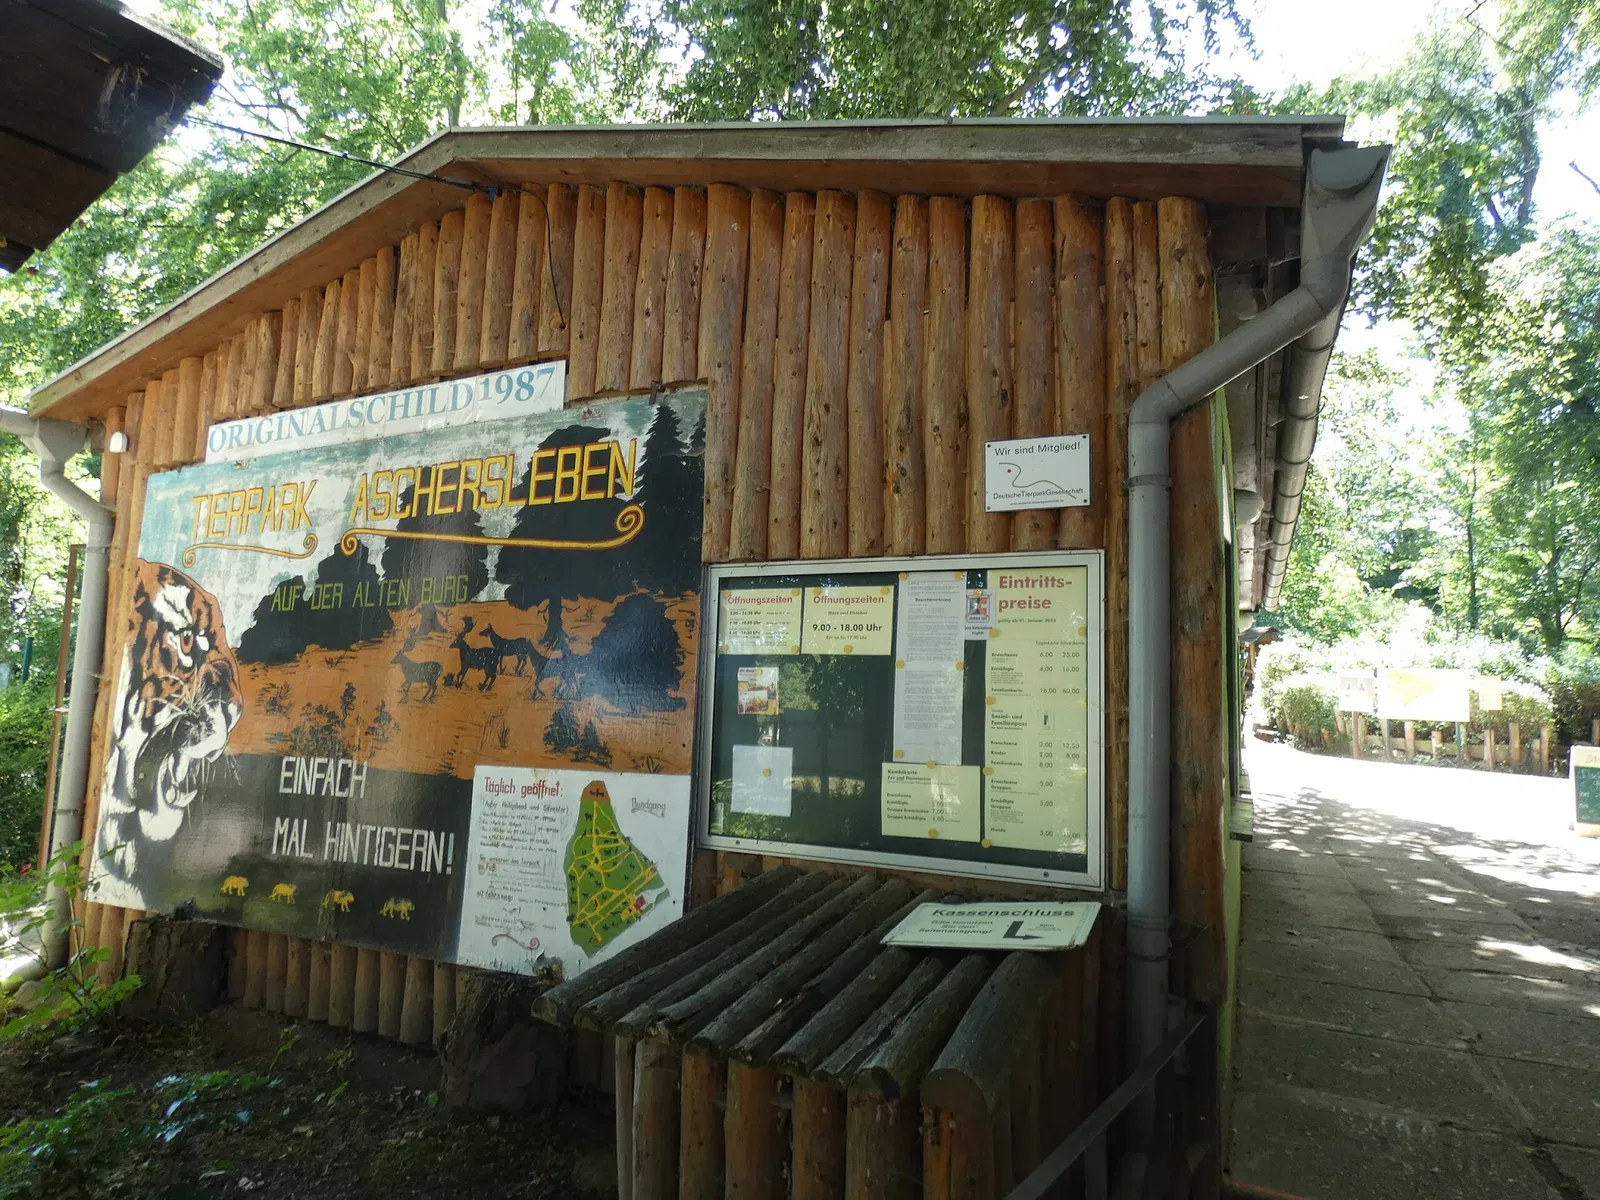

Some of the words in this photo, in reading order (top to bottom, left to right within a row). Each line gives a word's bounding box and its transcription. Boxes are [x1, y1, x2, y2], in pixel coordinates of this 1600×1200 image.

[209, 383, 473, 453] ORIGINALSCHILD
[480, 366, 556, 405] 1987
[995, 447, 1011, 456] Wir
[1014, 445, 1034, 455] sind
[1038, 442, 1080, 453] Mitglied!
[191, 480, 317, 541] TIERPARK
[349, 438, 637, 525] ASCHERSLEBEN
[999, 575, 1072, 589] Eintritts-
[271, 585, 303, 613] AUF
[310, 582, 344, 609] DER
[352, 578, 410, 607] ALTEN
[420, 575, 469, 604] BURG
[999, 596, 1052, 613] preise
[812, 624, 831, 632] 9.00
[840, 624, 864, 632] 18.00
[866, 624, 882, 632] Uhr
[279, 756, 368, 798] EINFACH
[484, 777, 516, 797] Täglich
[521, 780, 563, 799] geöffnet:
[632, 797, 666, 812] Rundgang
[272, 816, 313, 858] MAL
[323, 821, 455, 875] HINTIGERN!
[932, 909, 1075, 917] Kassenschluss
